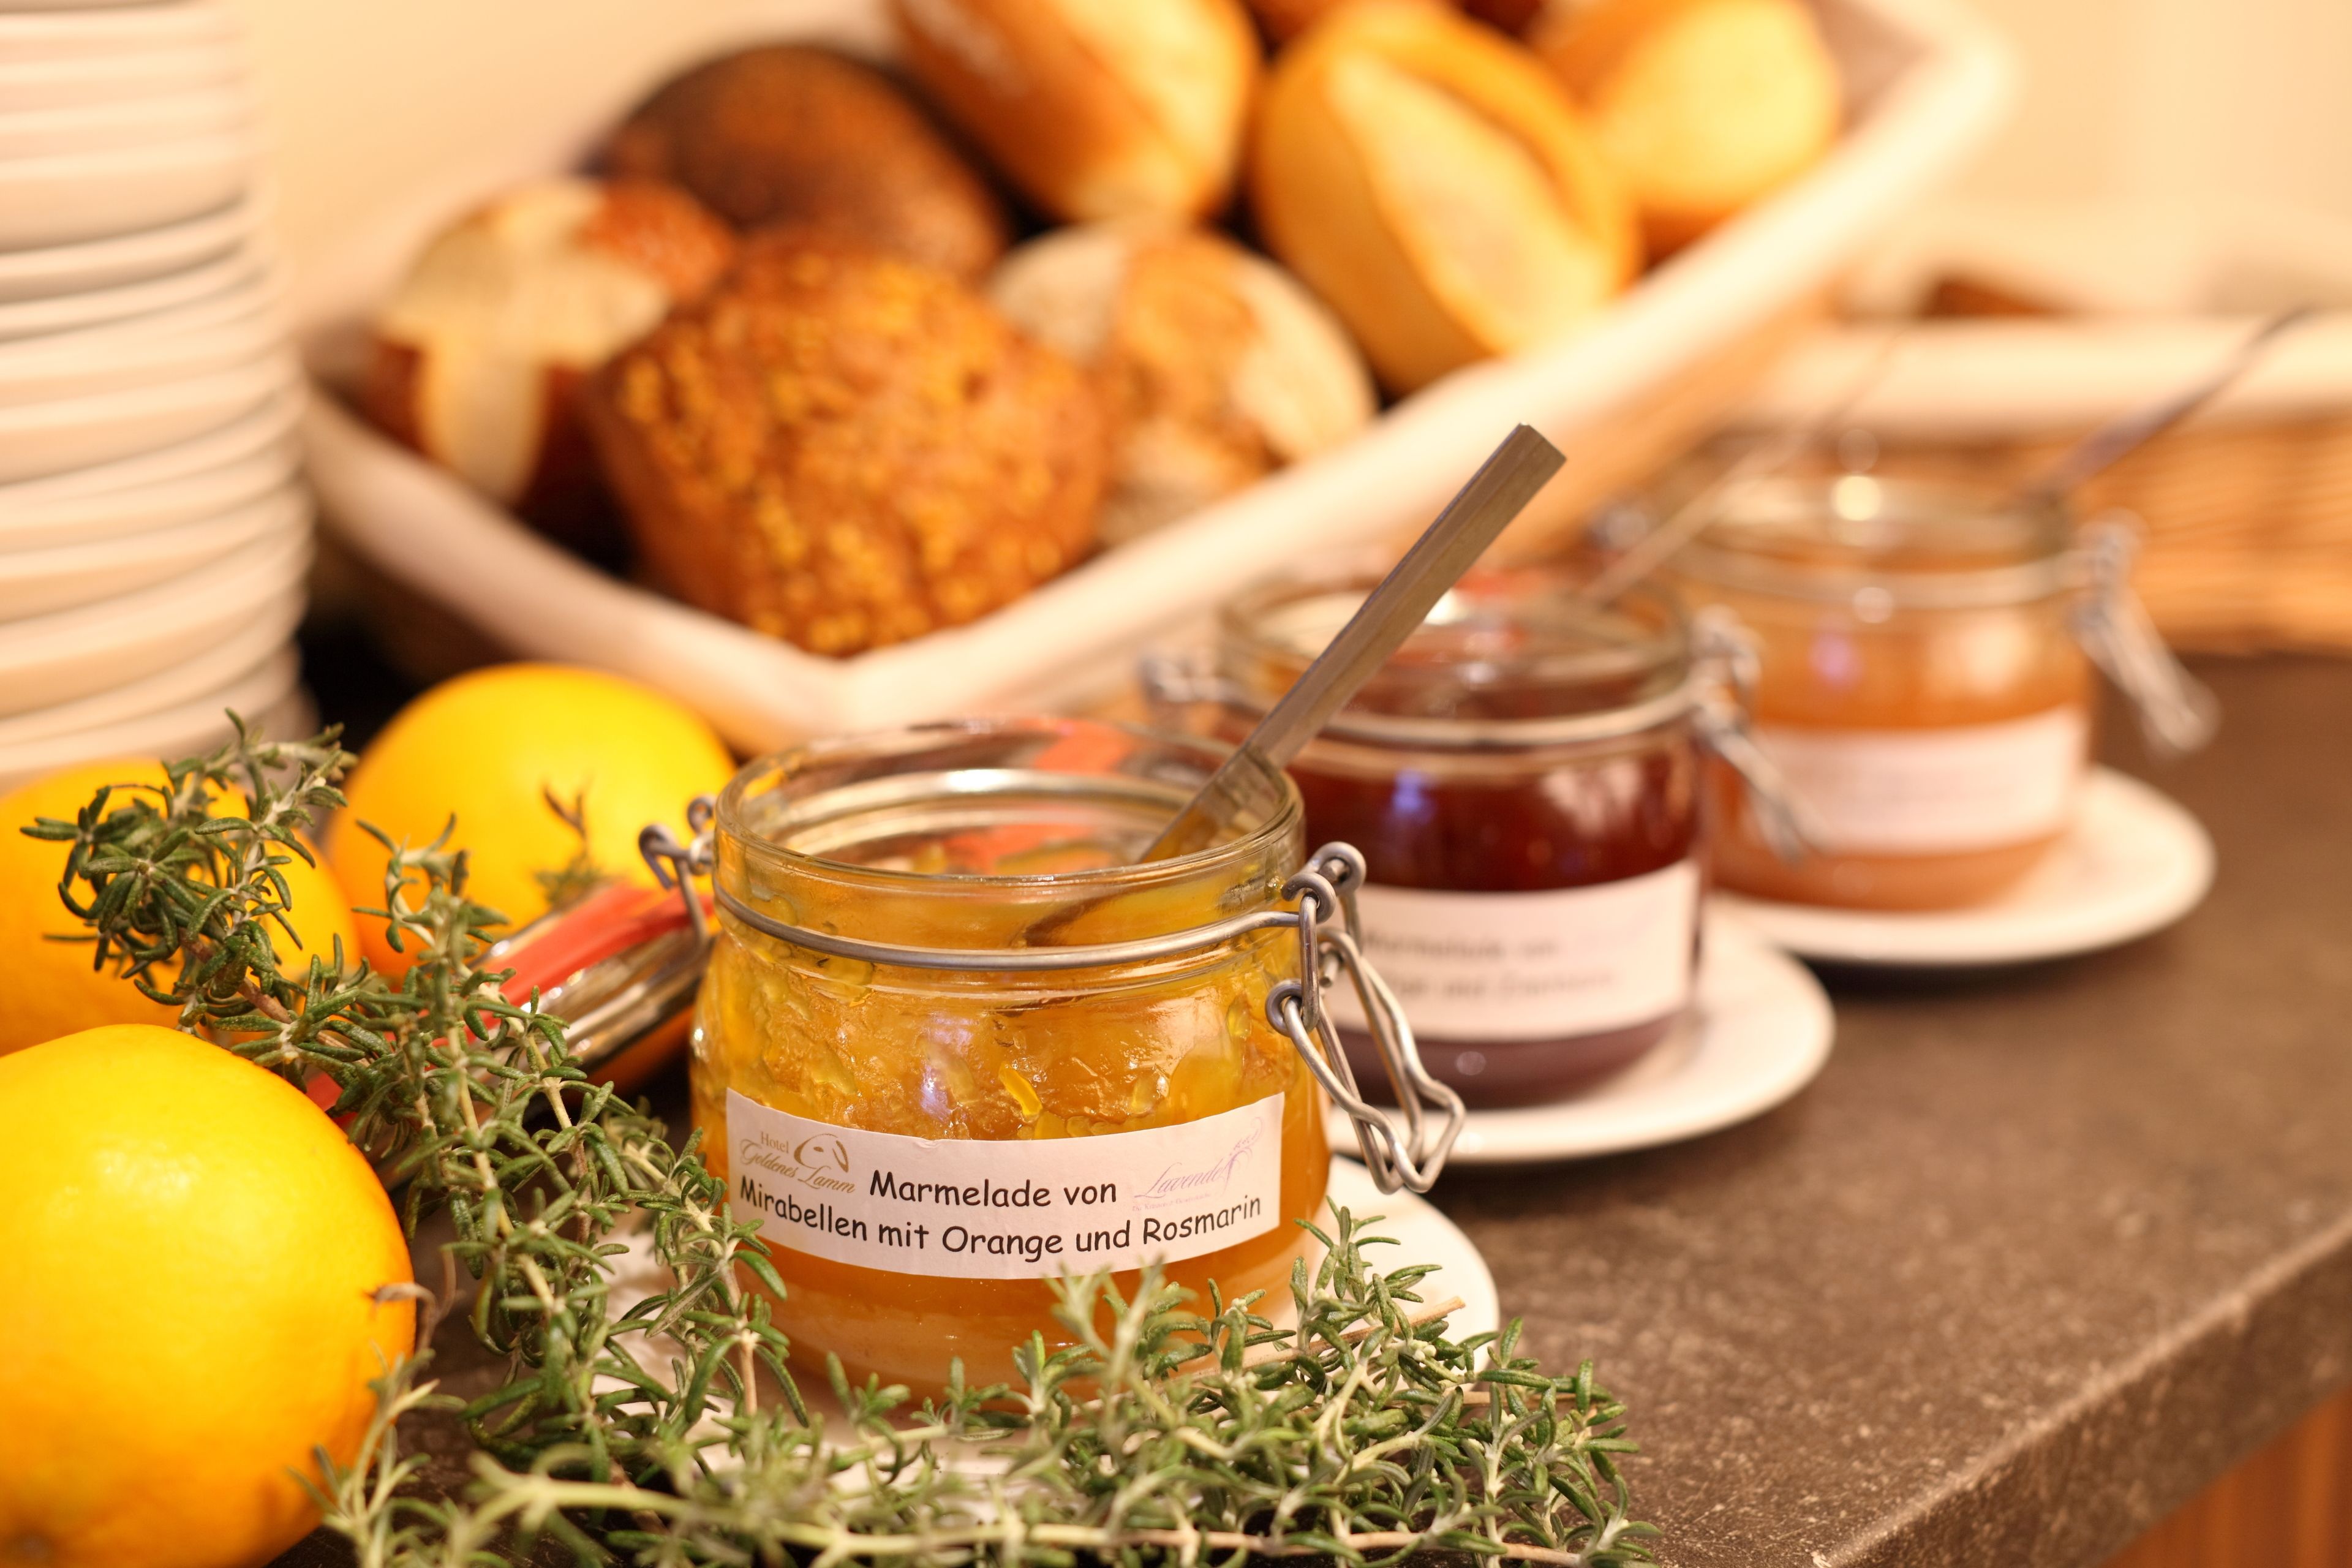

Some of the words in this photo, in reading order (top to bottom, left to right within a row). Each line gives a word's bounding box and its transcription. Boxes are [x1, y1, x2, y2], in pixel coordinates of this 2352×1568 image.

[761, 1131, 789, 1154] Hotel
[740, 1139, 799, 1178] Goldenes
[797, 1166, 856, 1194] Lamm
[870, 1169, 1051, 1207] Marmelade
[1063, 1183, 1117, 1205] von
[741, 1175, 867, 1242] Mirabellen
[879, 1221, 930, 1250] mit
[942, 1225, 1063, 1263] Orange
[1076, 1219, 1131, 1253] und
[1143, 1194, 1261, 1245] Rosmarin
